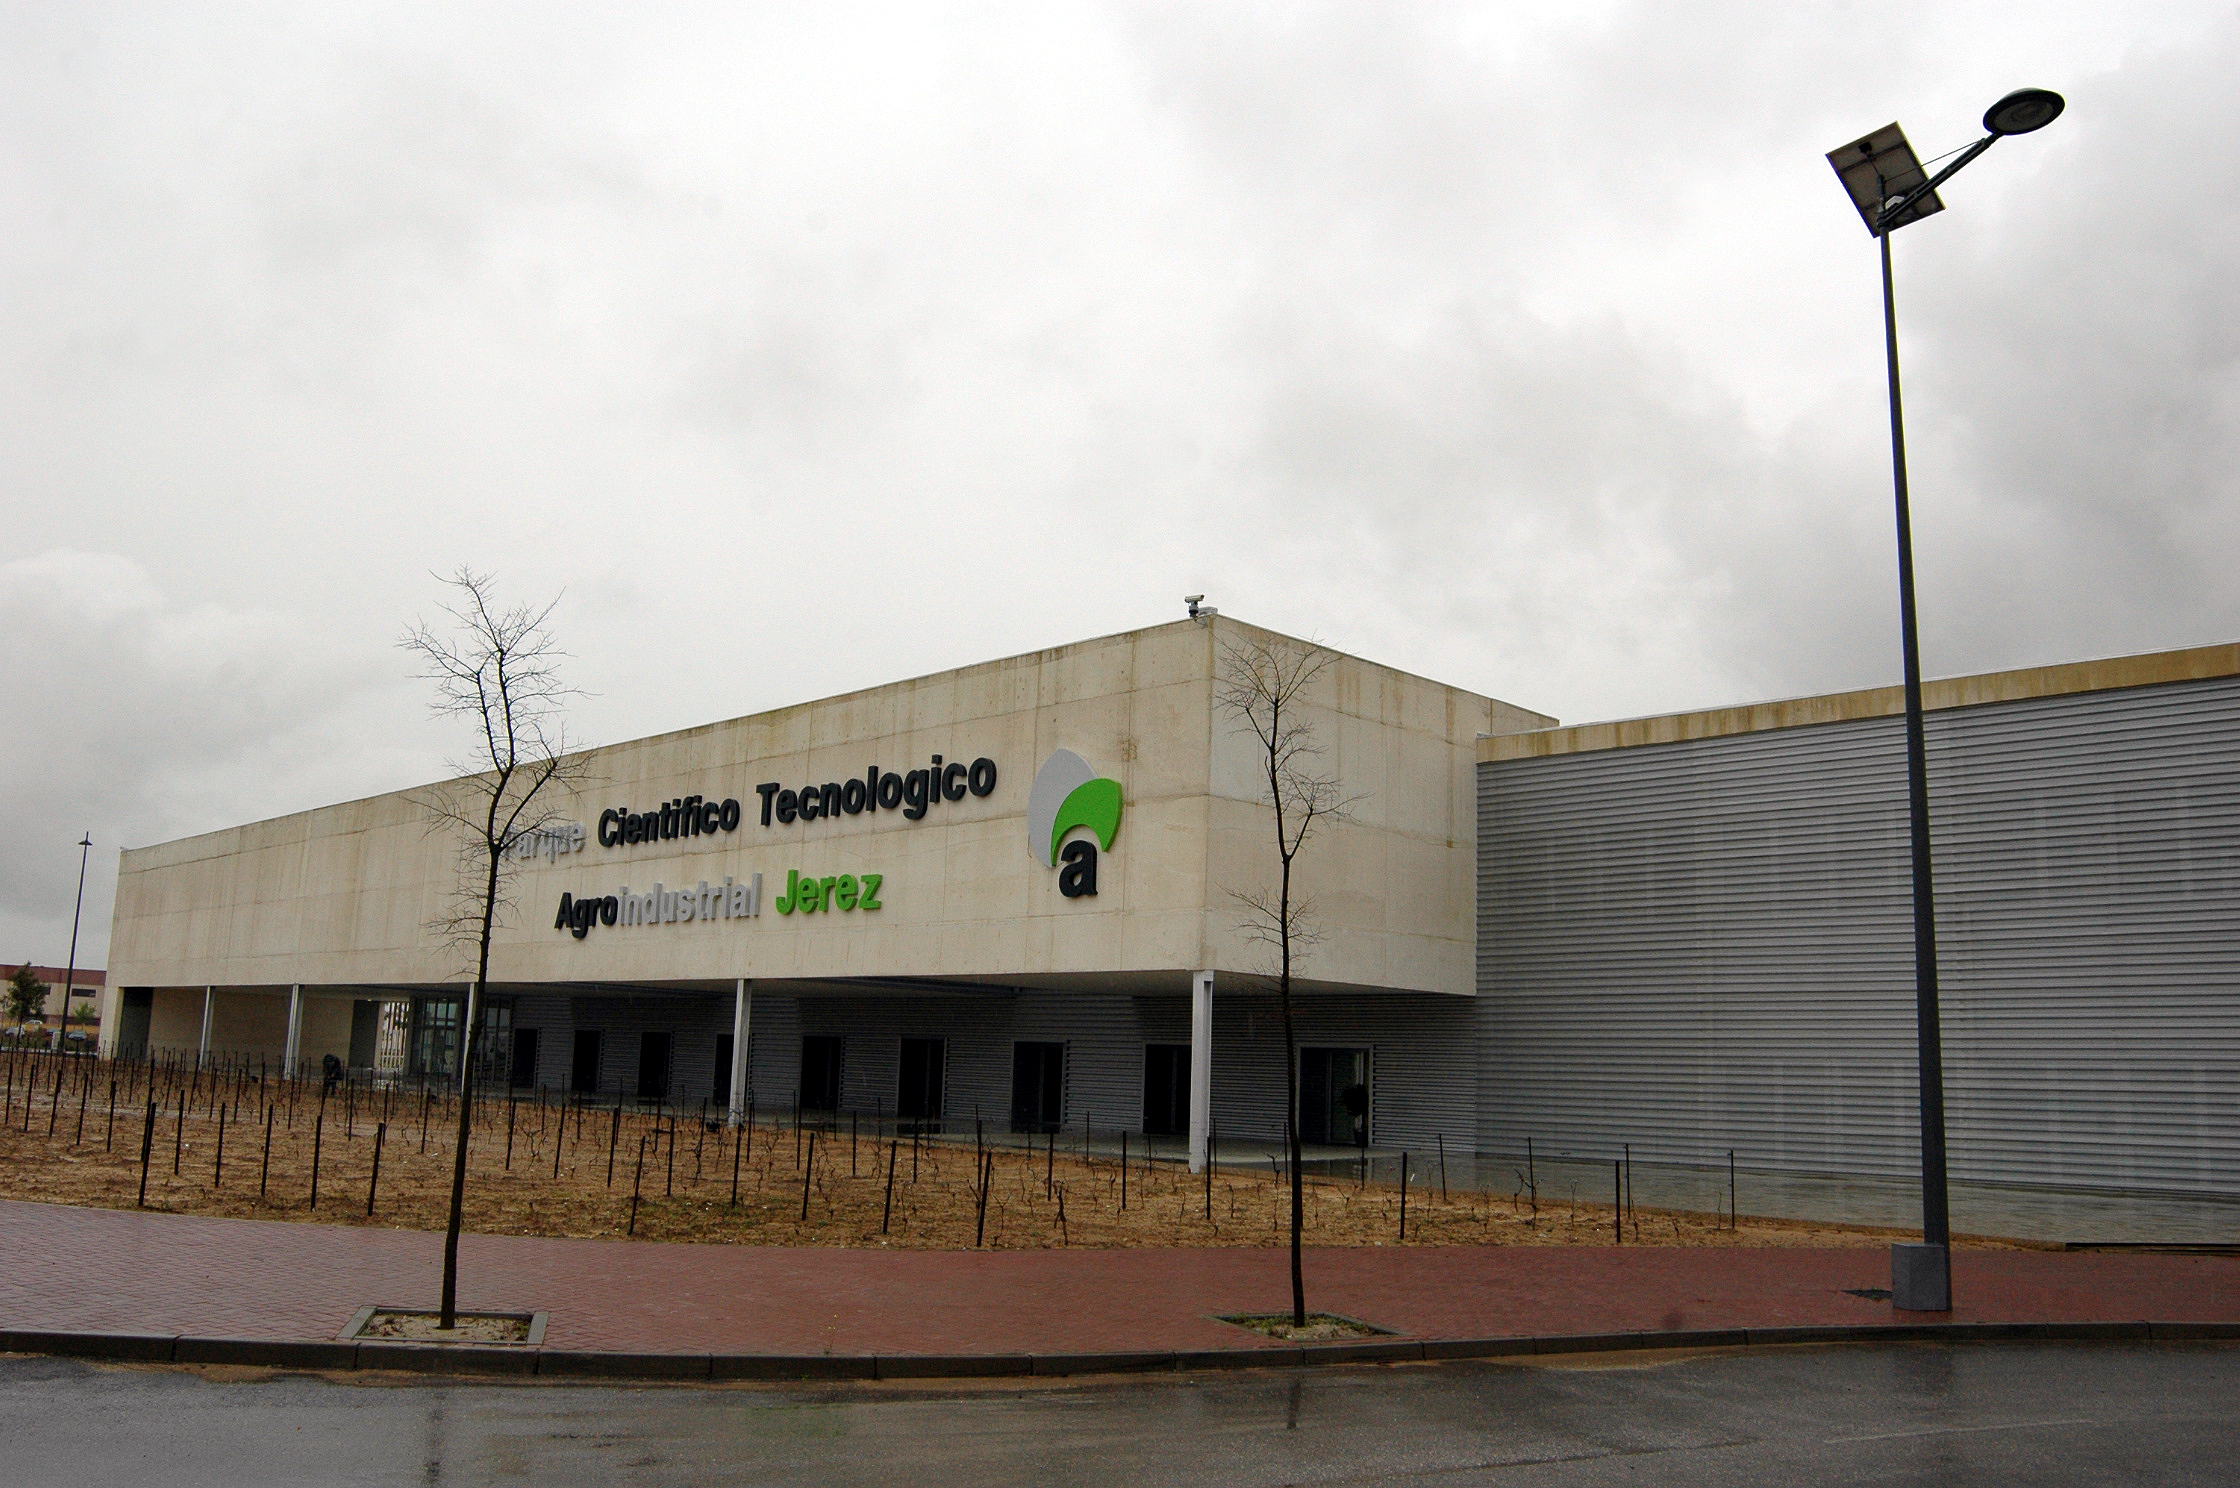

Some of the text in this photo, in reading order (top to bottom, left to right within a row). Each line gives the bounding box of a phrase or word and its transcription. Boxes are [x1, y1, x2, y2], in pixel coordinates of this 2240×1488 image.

[598, 794, 740, 847] Cientifico
[756, 754, 997, 826] Tecnologico
[1058, 839, 1098, 898] a
[554, 869, 883, 939] Agroindustrial Jerez
